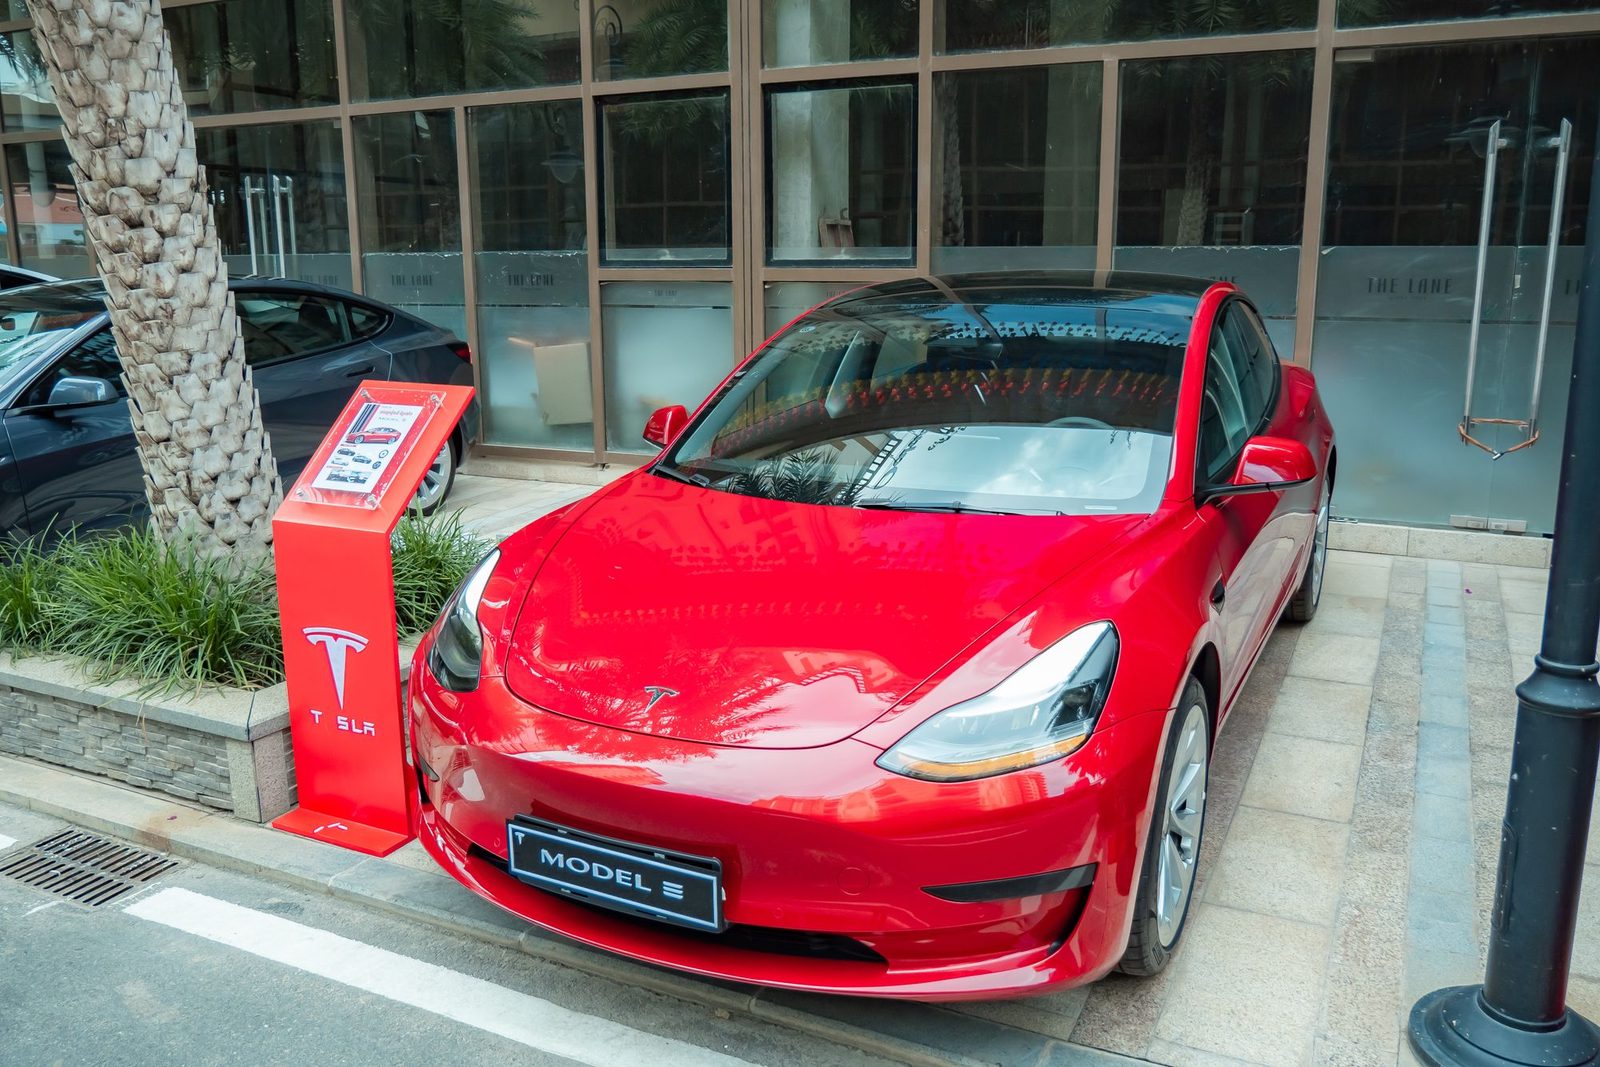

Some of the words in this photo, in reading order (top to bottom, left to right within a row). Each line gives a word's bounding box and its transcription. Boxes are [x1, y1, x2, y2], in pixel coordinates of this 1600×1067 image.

[1367, 278, 1398, 294] THE
[1408, 278, 1453, 294] LANE
[540, 848, 652, 892] MODEL
